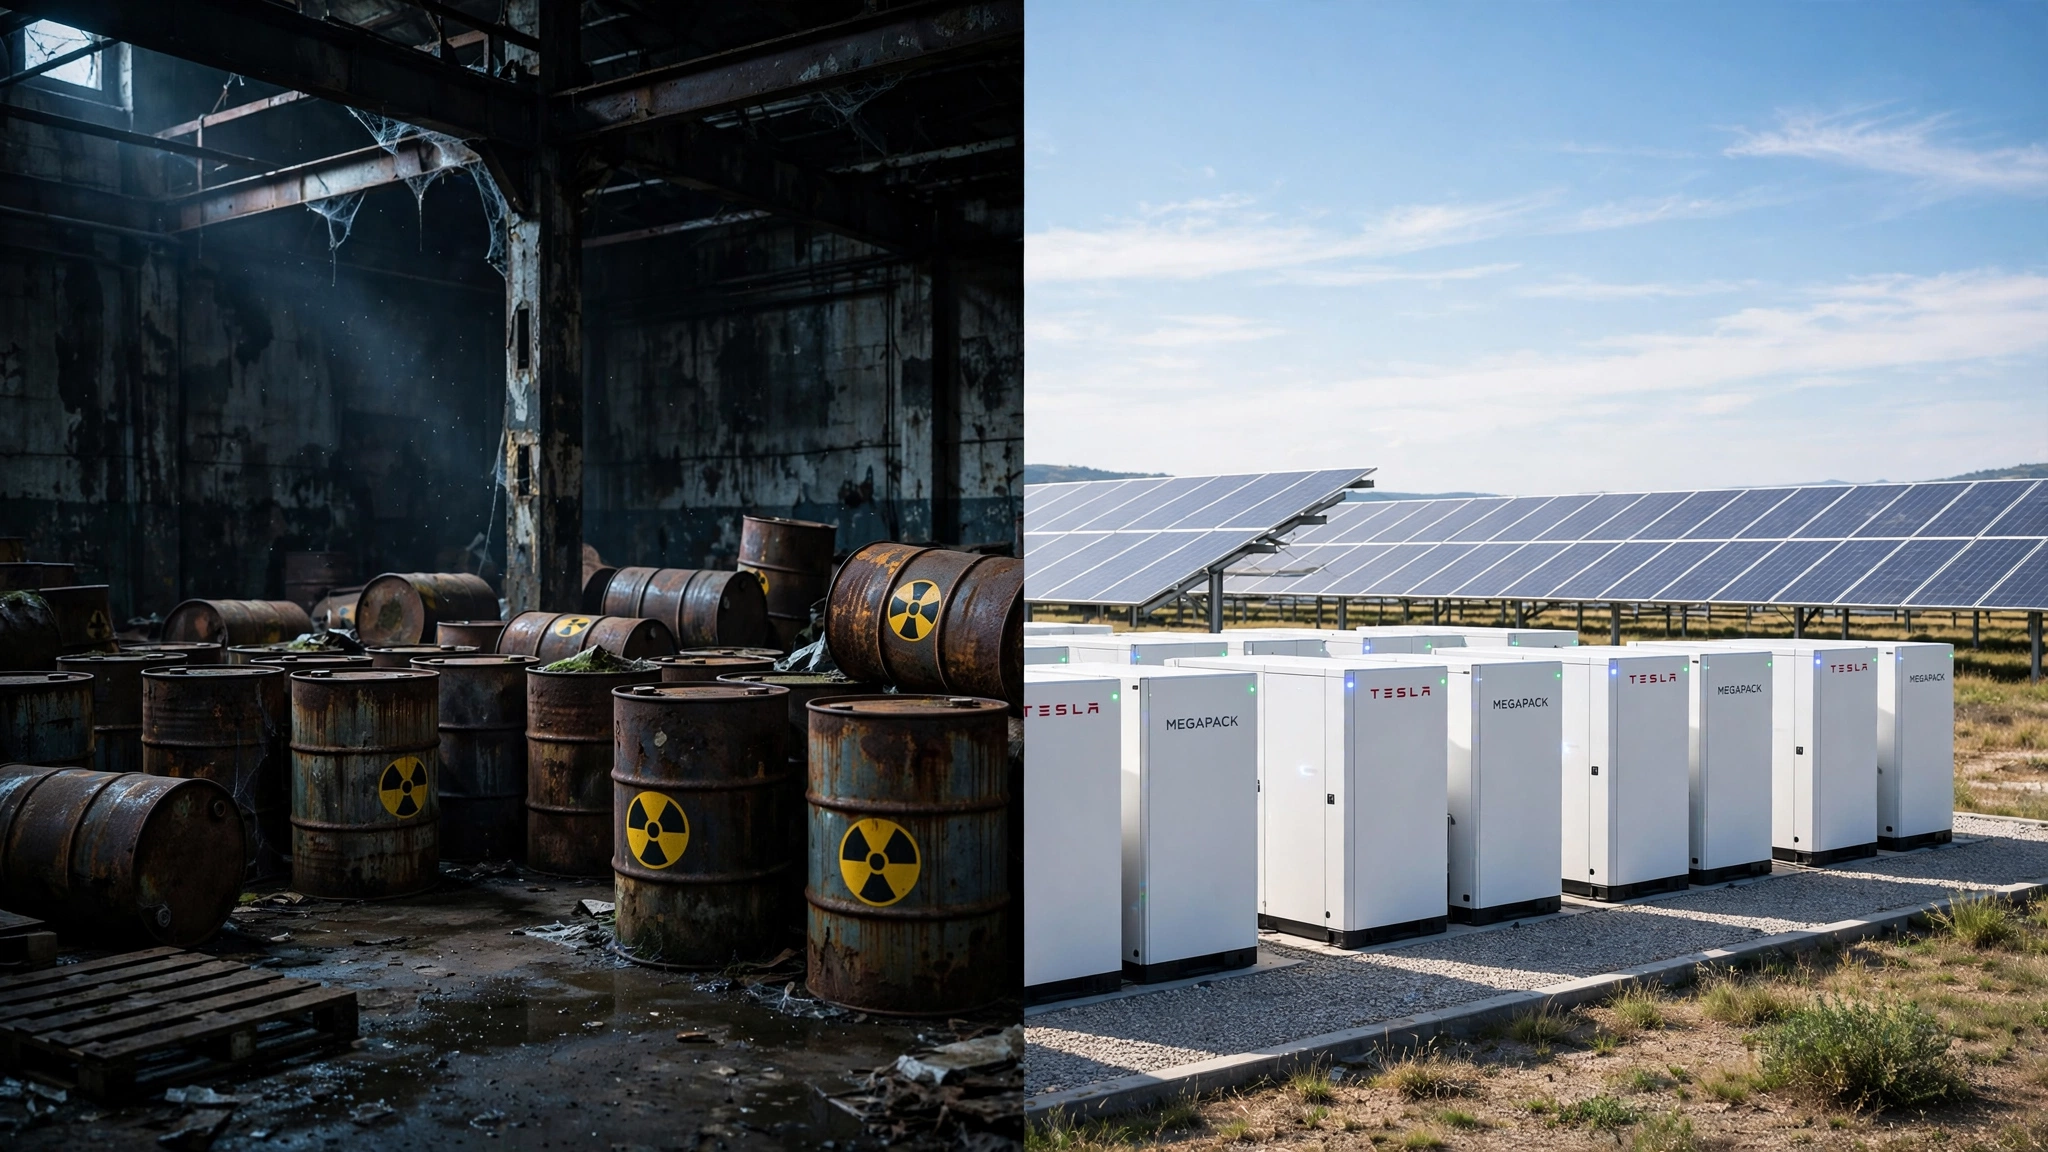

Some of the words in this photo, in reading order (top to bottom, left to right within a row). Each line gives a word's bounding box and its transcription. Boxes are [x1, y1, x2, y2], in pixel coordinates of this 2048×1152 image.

[1830, 663, 1868, 674] TESLA
[1629, 673, 1676, 684] TESLA
[1909, 673, 1946, 683] MEGAPACK
[1370, 686, 1431, 699] TESLA
[1717, 684, 1763, 695] MEGAPACK
[1024, 702, 1099, 717] TESLA
[1492, 697, 1549, 710] MEGAPACK
[1166, 715, 1239, 731] MEGAPACK
